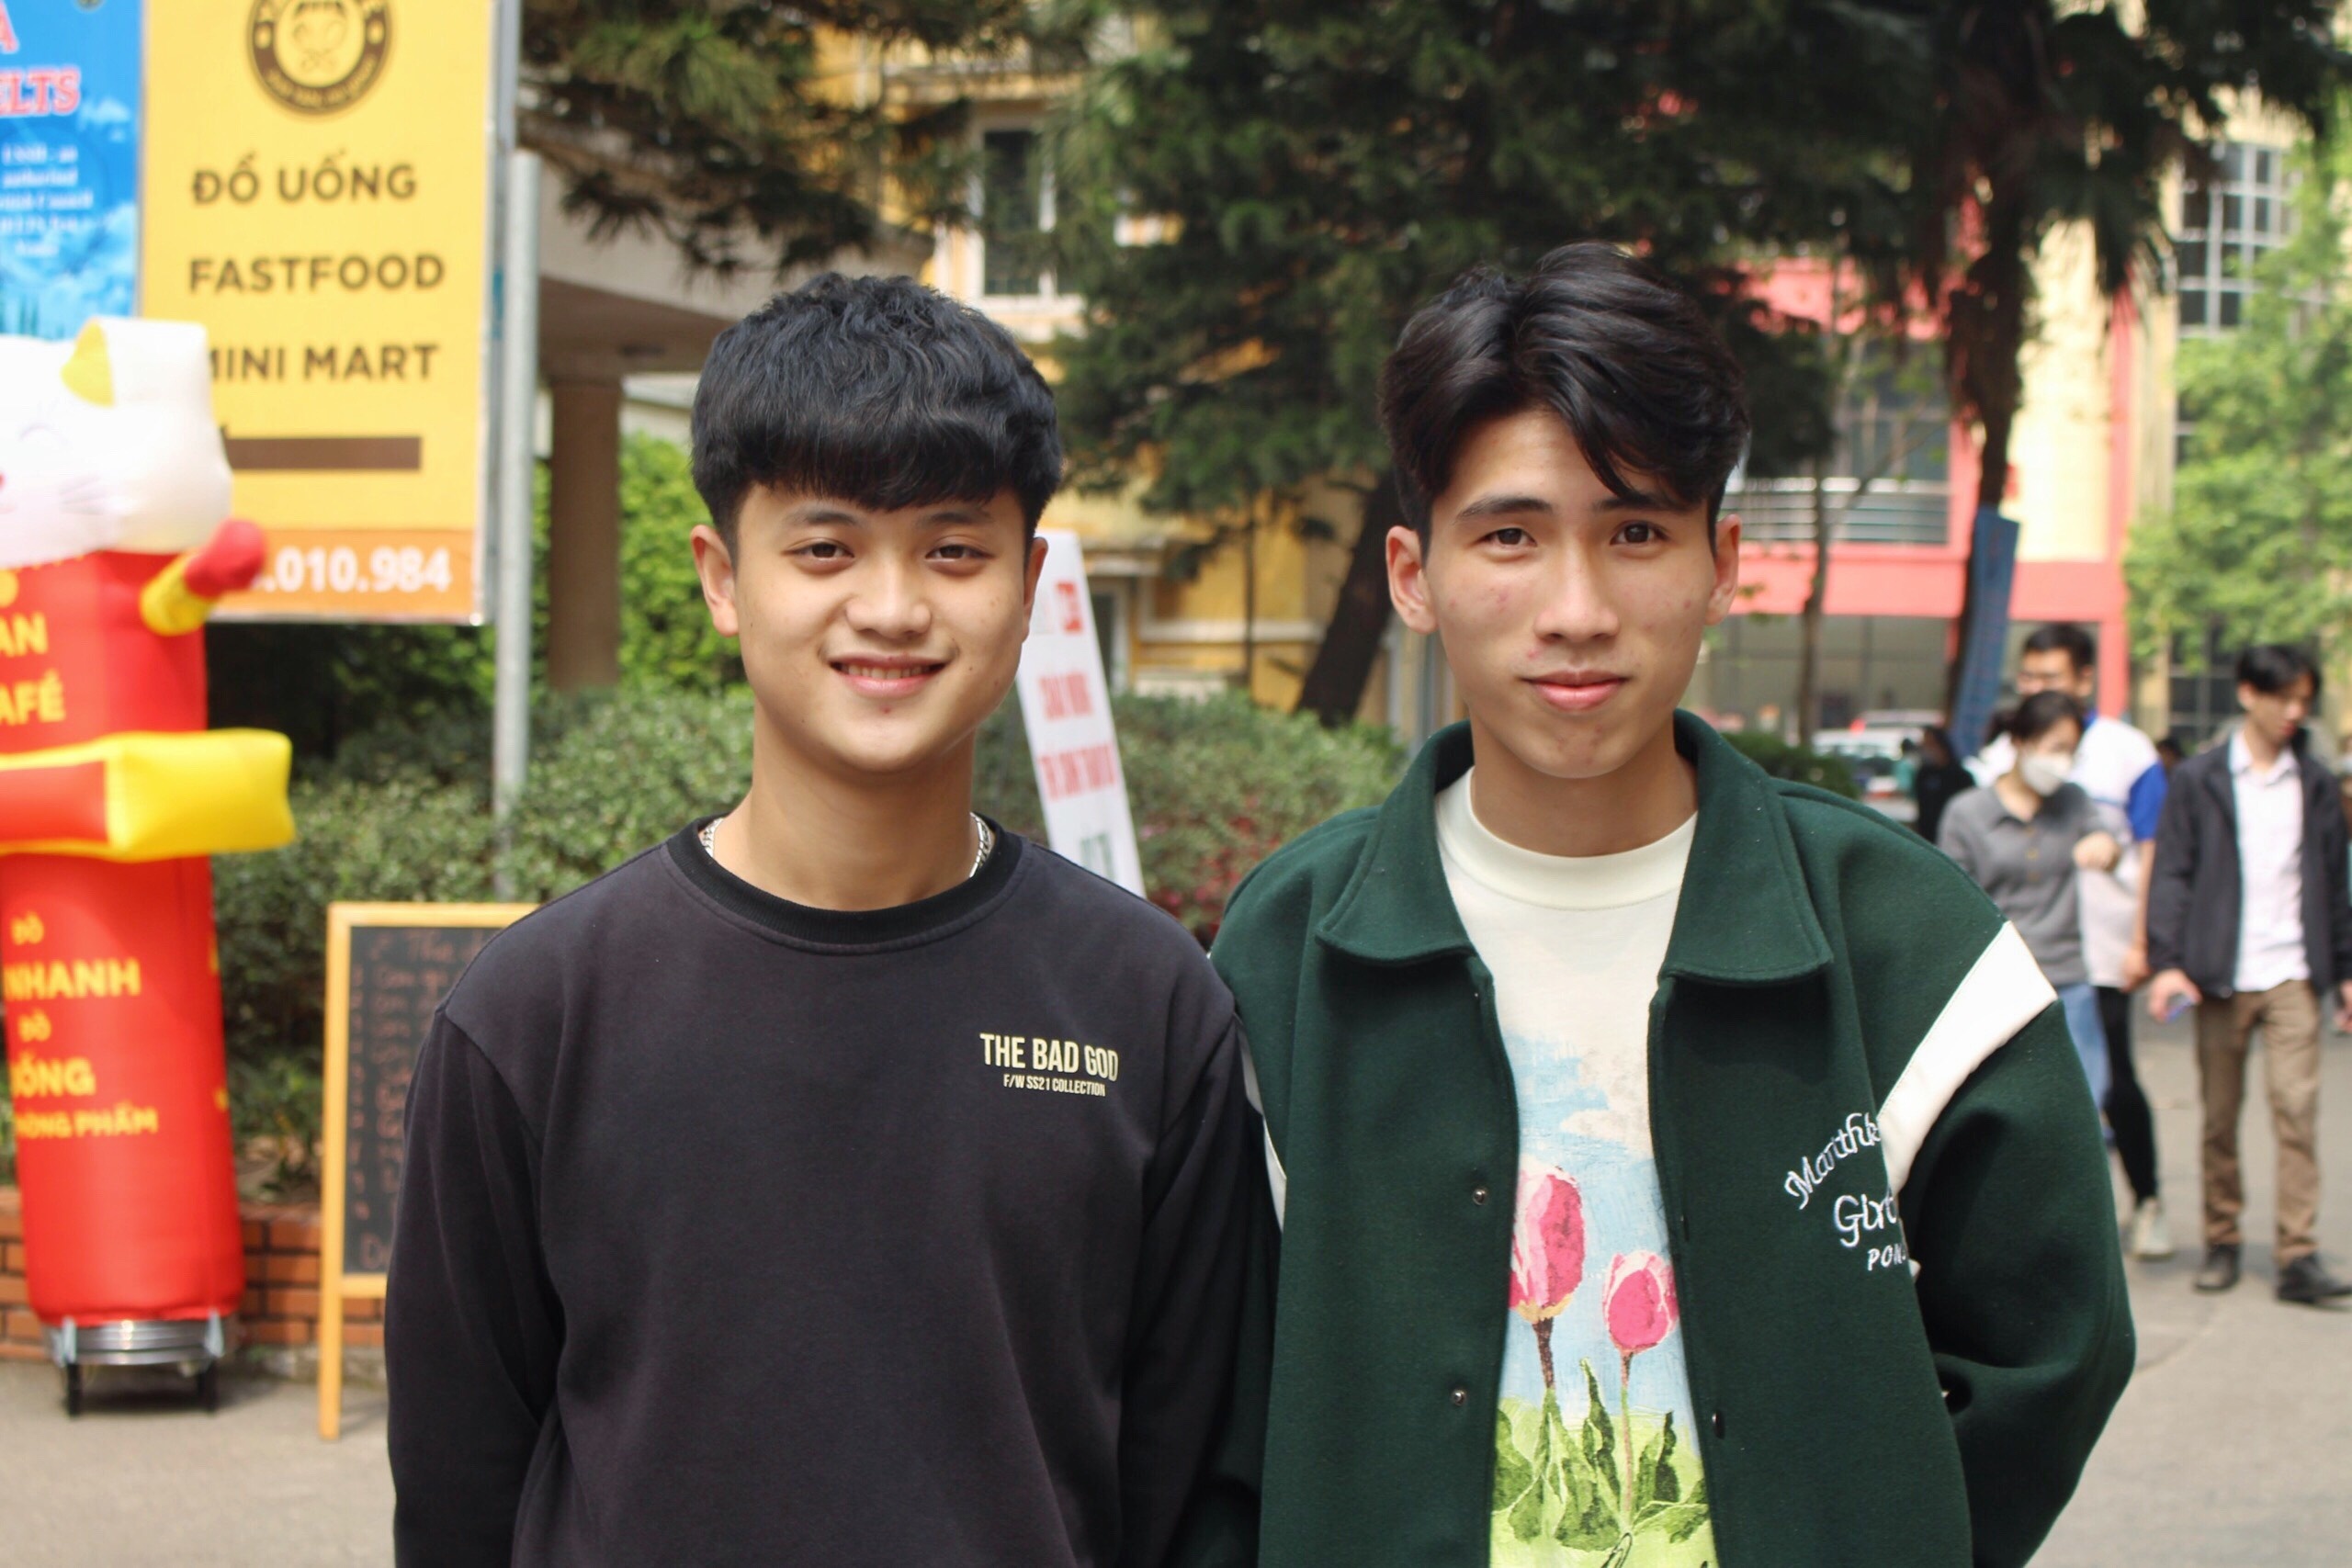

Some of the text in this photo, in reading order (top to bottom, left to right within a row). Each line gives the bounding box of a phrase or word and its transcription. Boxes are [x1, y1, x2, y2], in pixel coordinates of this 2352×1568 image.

[277, 148, 417, 203] UỐNG
[189, 253, 445, 294] FASTFOOD
[303, 344, 440, 382] MART
[252, 545, 452, 593] .010.984
[979, 1032, 1119, 1082] THE BAD GOD
[1003, 1073, 1106, 1097] F/W SS21 COLLECTION
